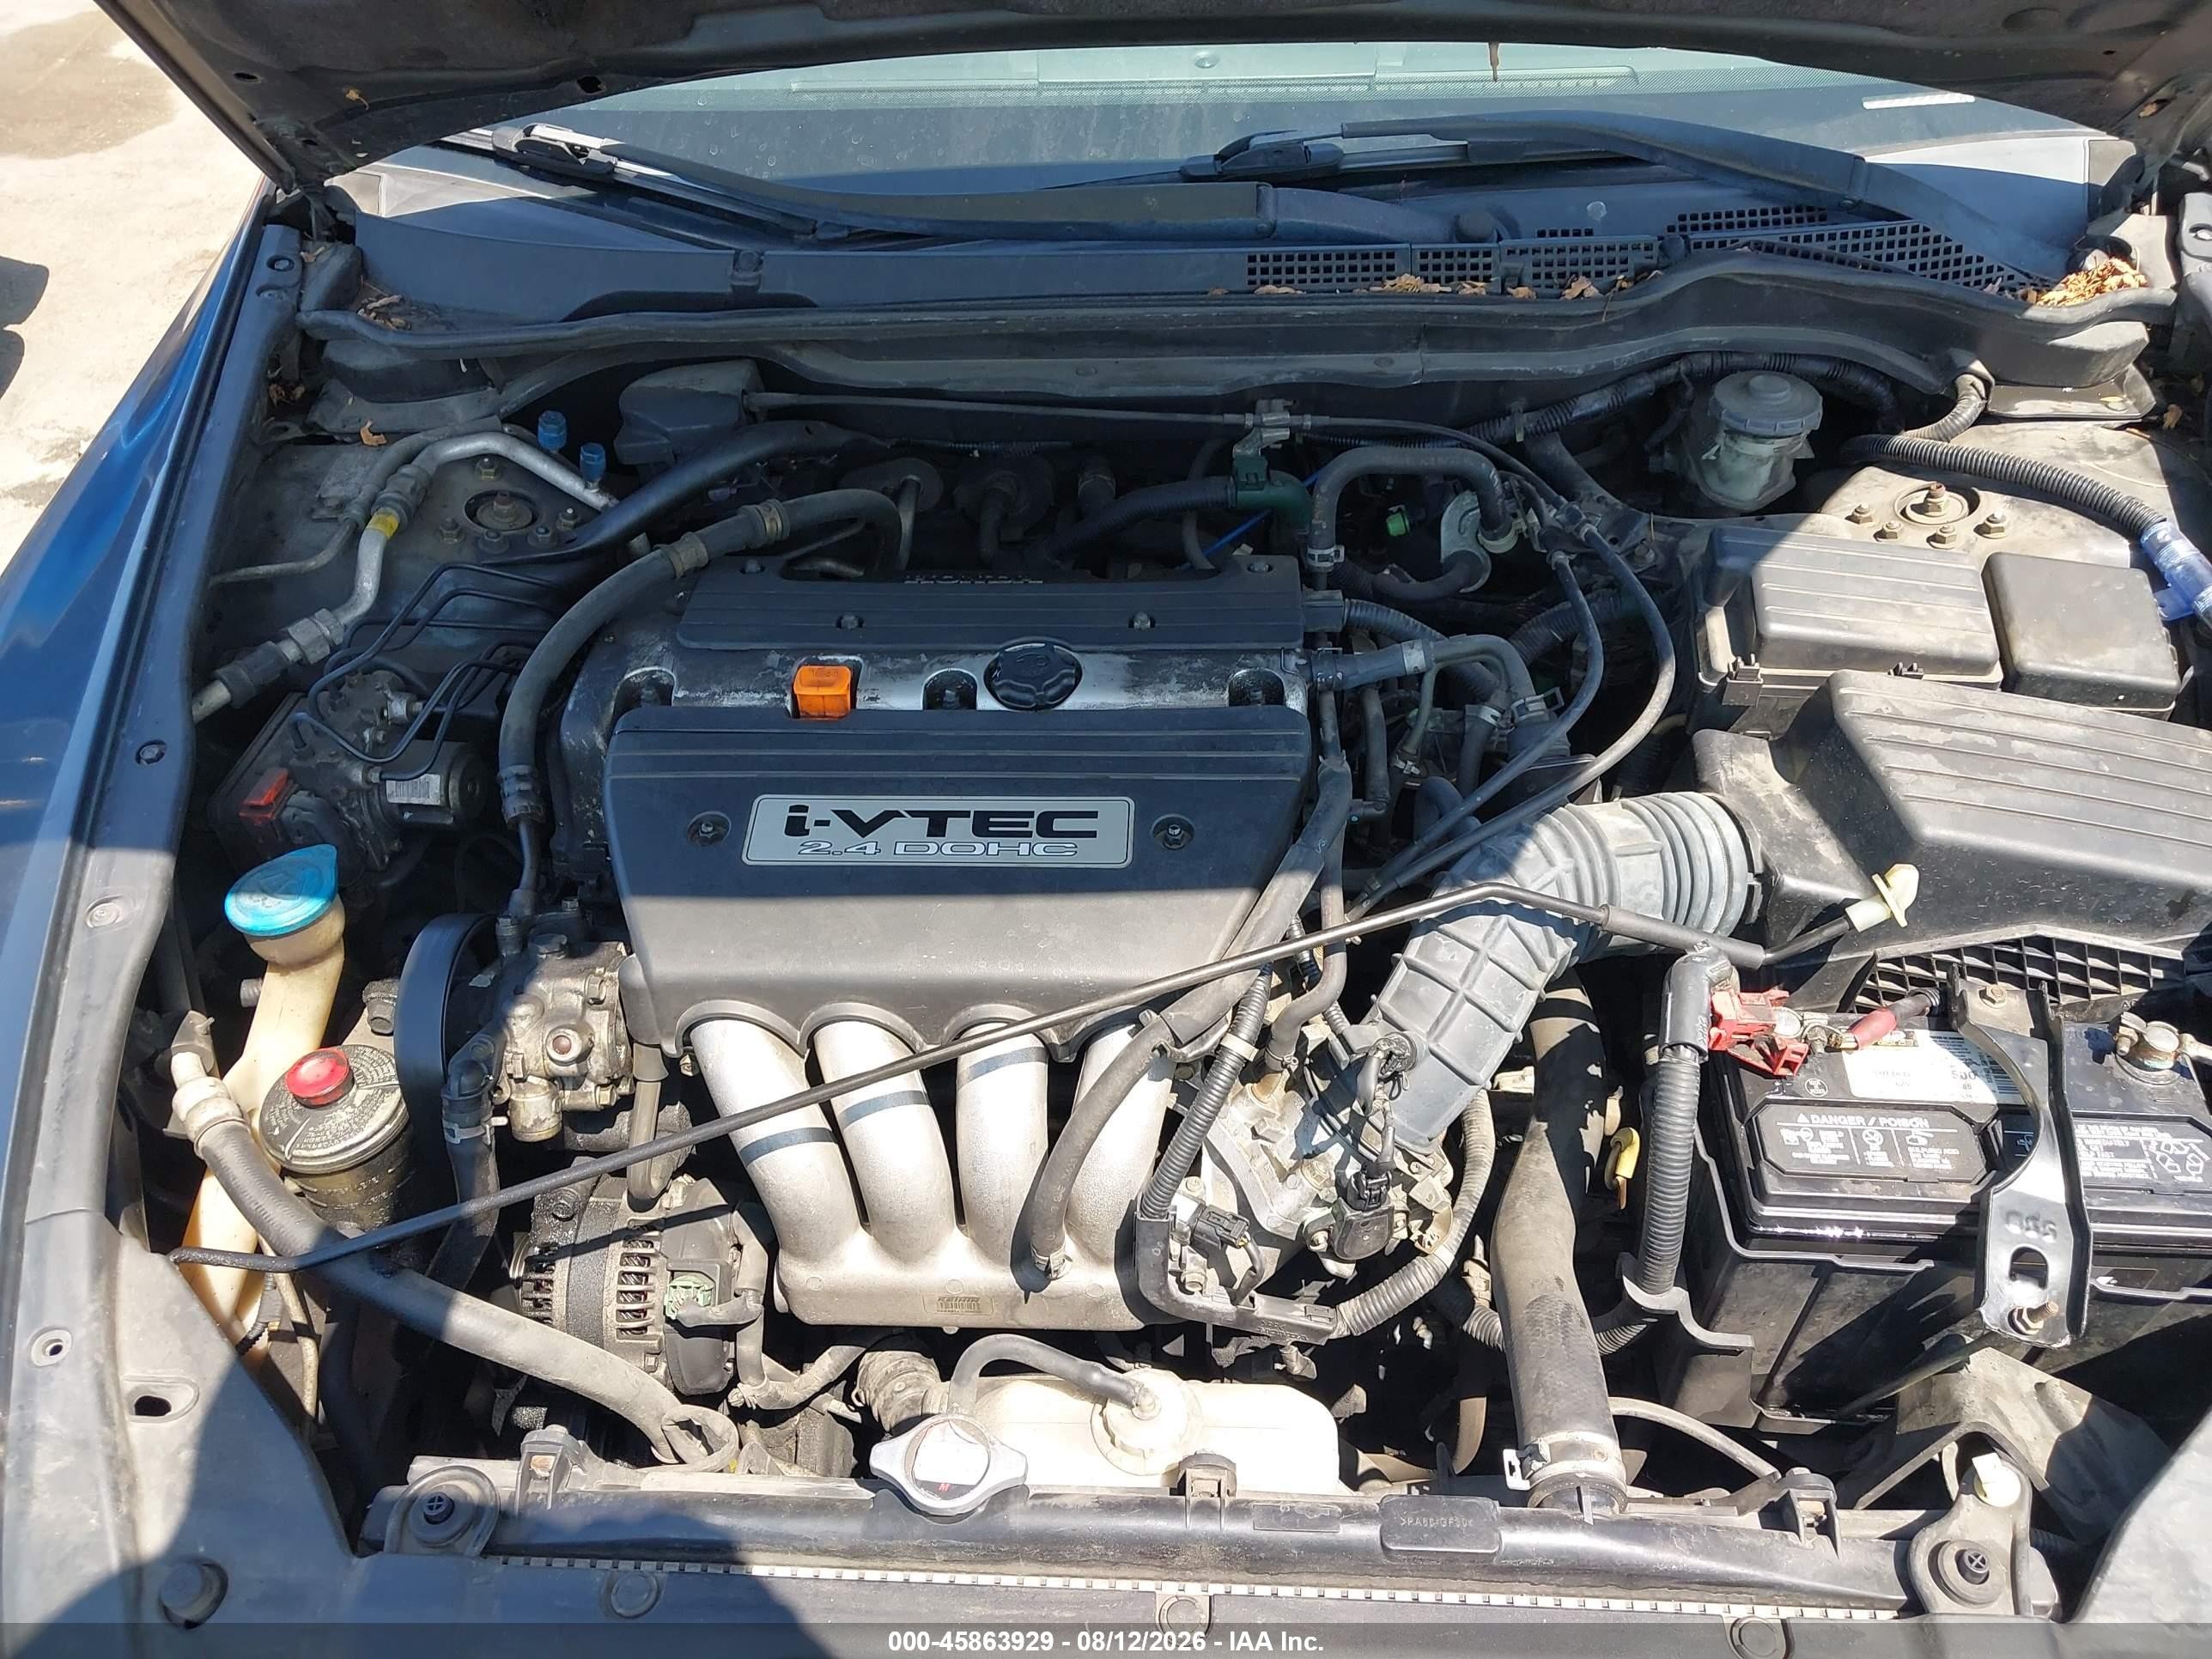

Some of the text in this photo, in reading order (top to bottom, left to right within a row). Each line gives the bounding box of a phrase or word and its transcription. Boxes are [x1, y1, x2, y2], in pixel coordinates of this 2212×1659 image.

[784, 805, 1099, 839] i-VTEC
[799, 841, 1079, 857] 2.4 DOHC
[1810, 1114, 1867, 1127] DANGER
[1880, 1117, 1930, 1129] POISON
